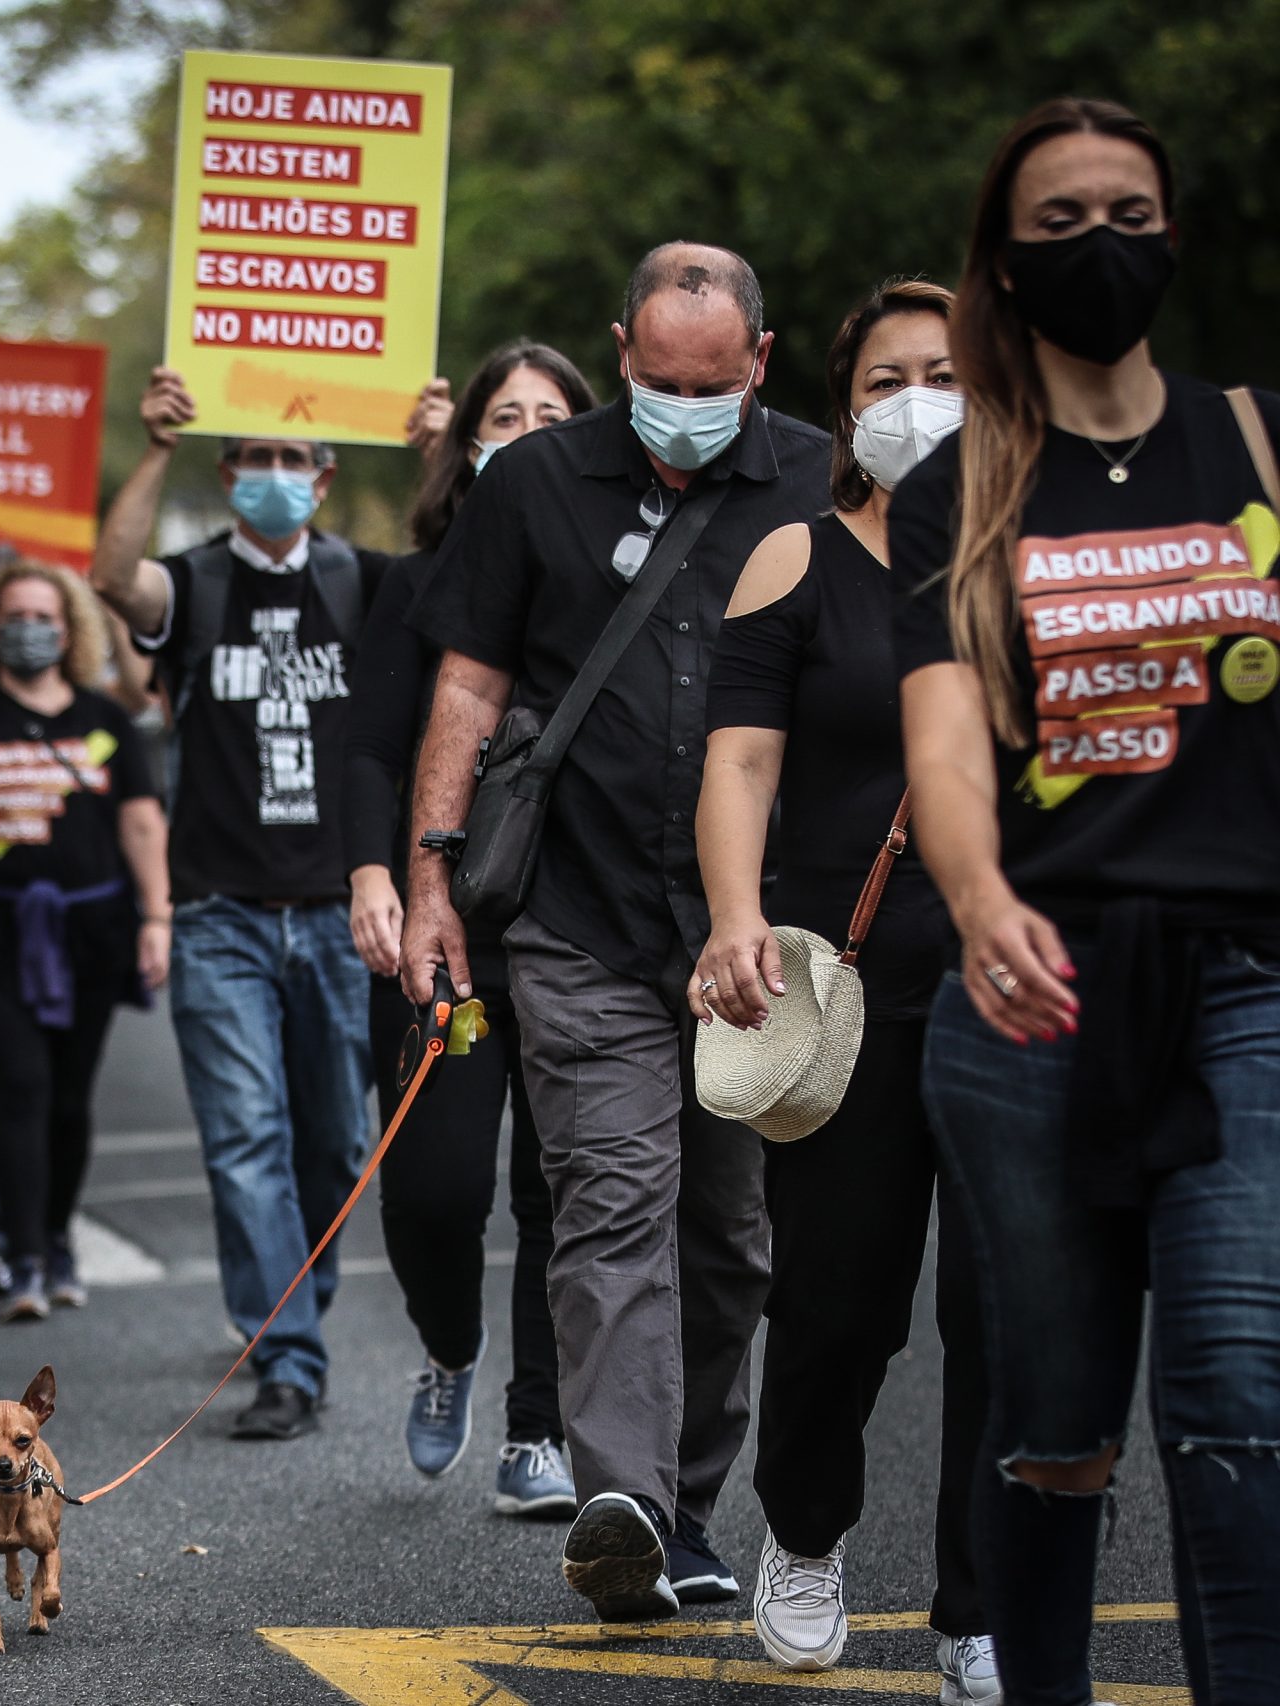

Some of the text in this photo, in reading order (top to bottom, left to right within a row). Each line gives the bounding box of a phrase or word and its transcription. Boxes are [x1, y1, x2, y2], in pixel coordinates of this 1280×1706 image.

[206, 87, 411, 128] HOJE AINDA
[203, 143, 350, 179] EXISTEM
[200, 198, 407, 239] MILHÕES DE
[197, 256, 376, 293] ESCRAVOS
[192, 310, 384, 351] NO MUNDO.
[1025, 539, 1247, 583] ABOLINDO A
[1045, 657, 1200, 702] PASSO A
[1050, 727, 1169, 764] PASSO
